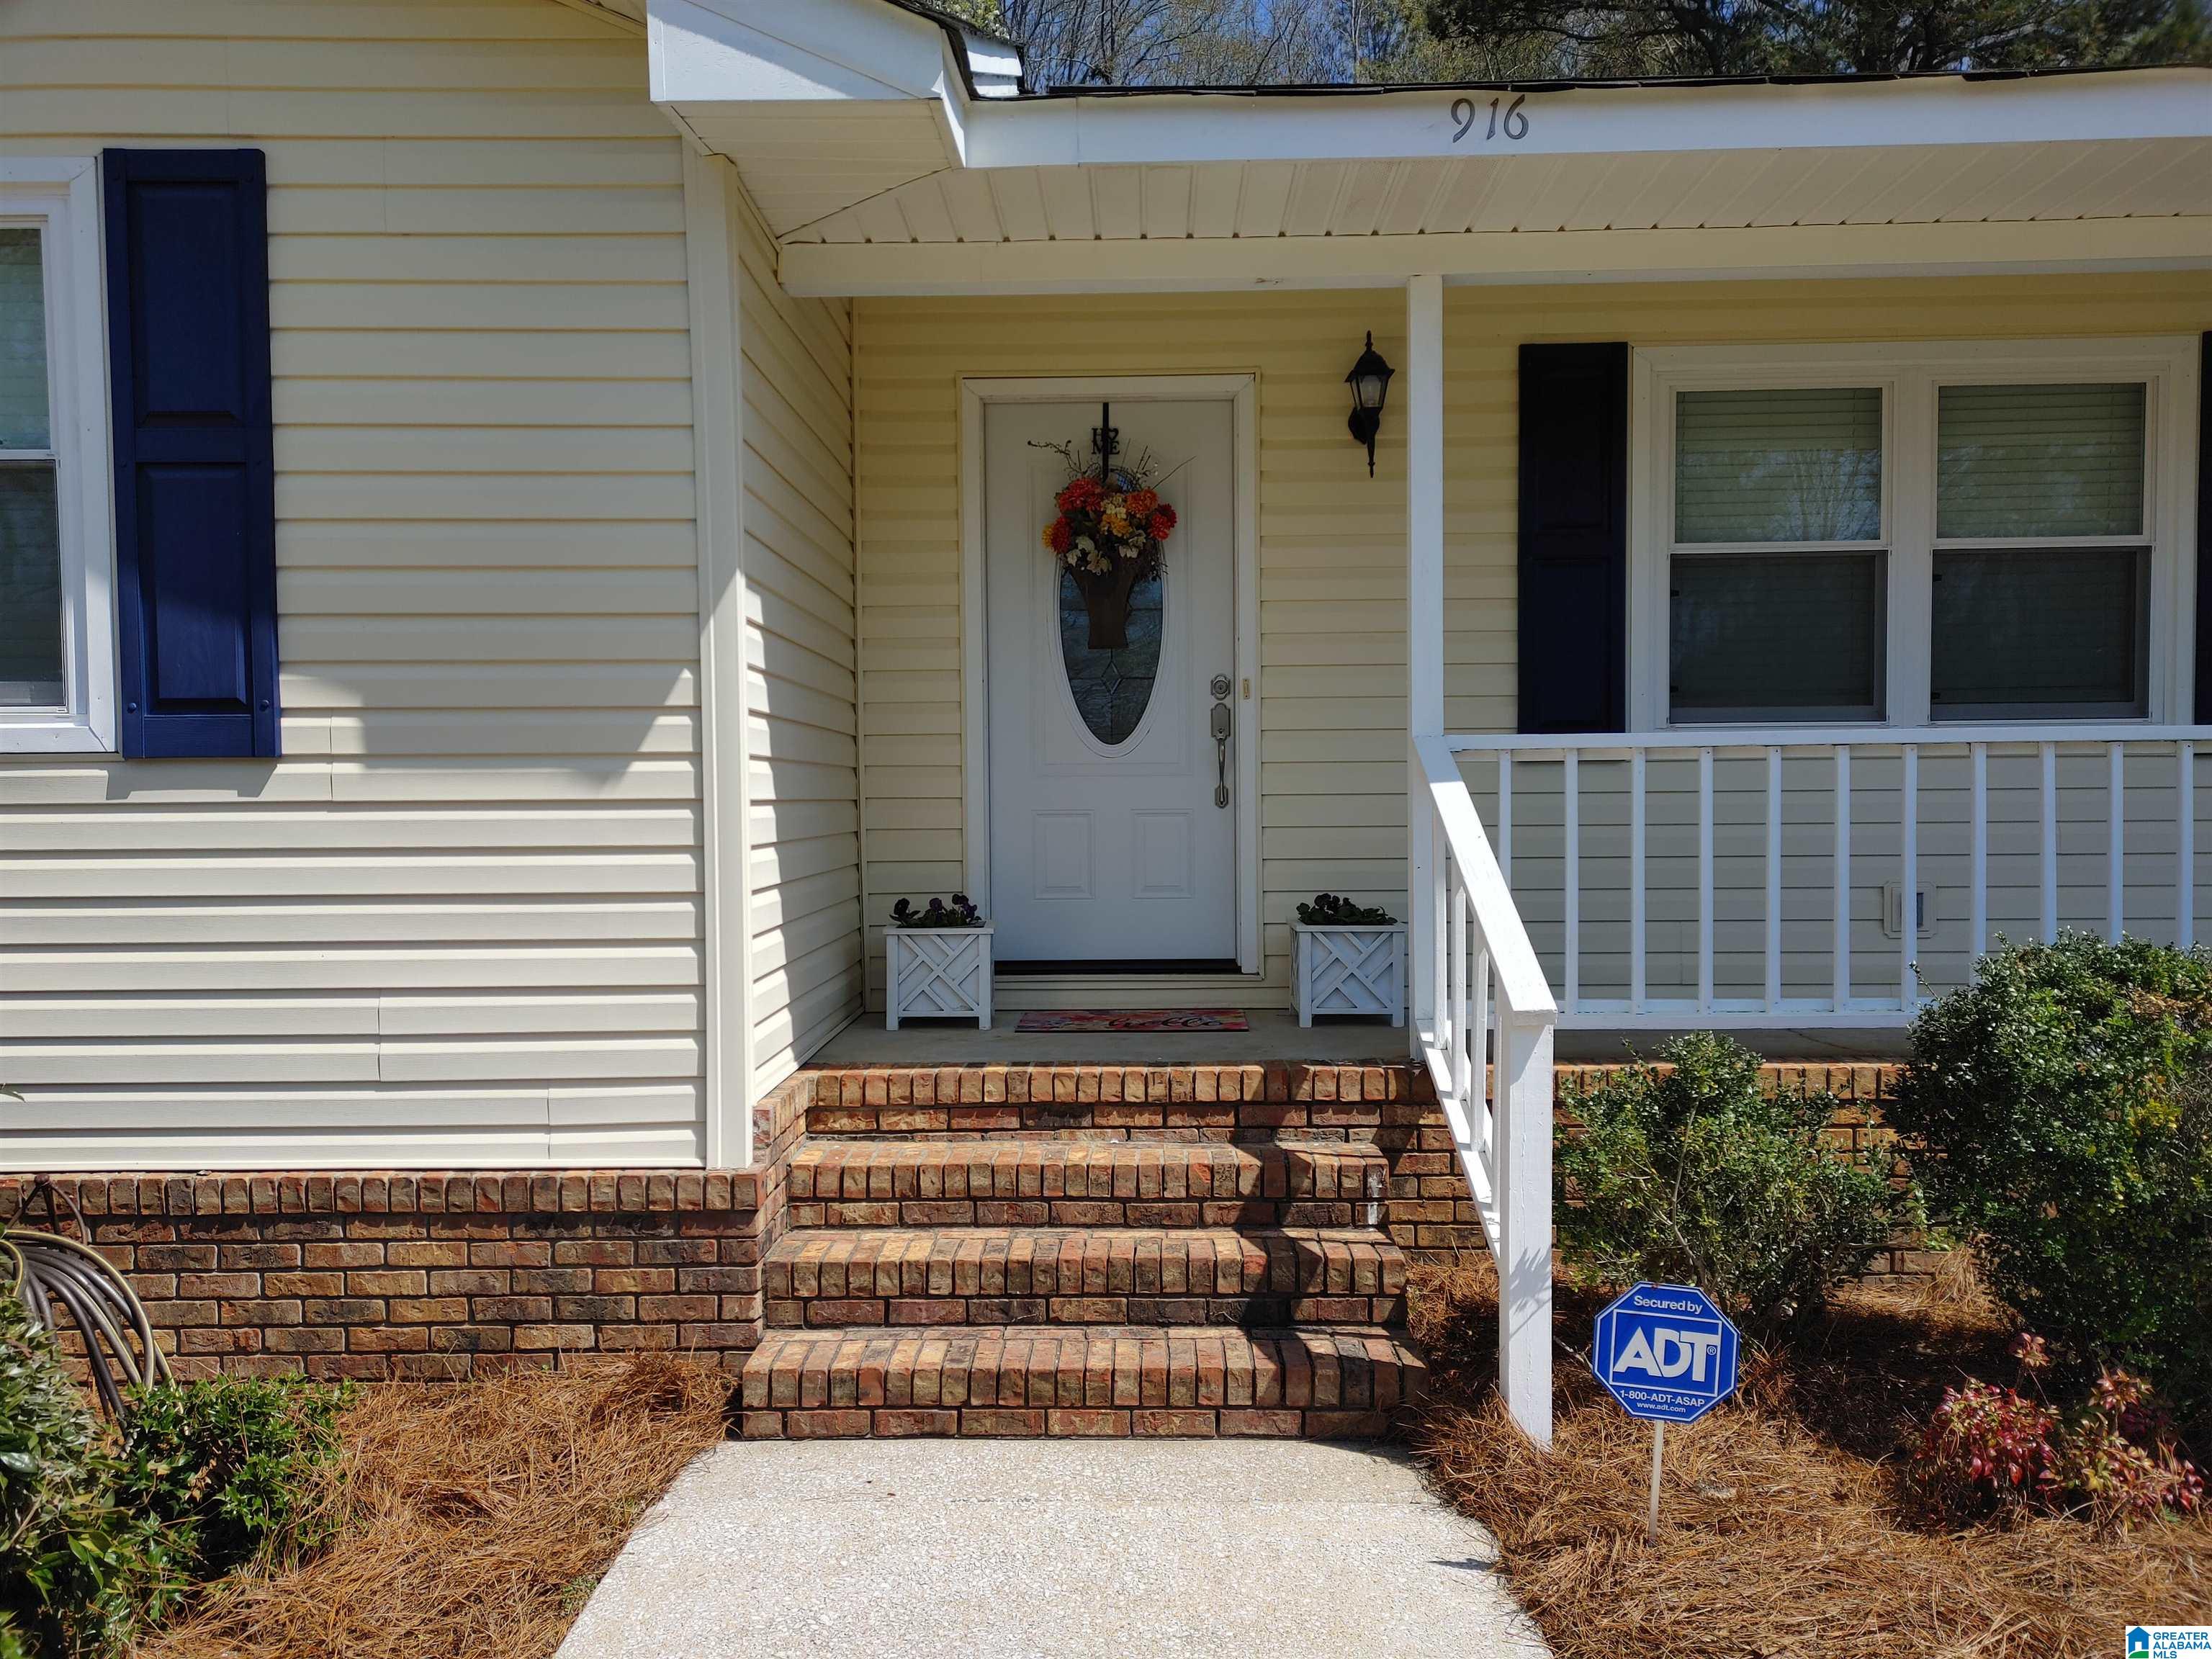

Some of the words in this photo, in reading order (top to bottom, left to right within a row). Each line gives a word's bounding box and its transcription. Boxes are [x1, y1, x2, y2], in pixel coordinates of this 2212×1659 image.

[1451, 94, 1529, 143] 916
[1633, 1295, 1686, 1311] Secured
[1686, 1301, 1703, 1315] by
[1612, 1326, 1720, 1382] ADT
[1619, 1390, 1705, 1407] 1-800-ADT-ASAP
[1636, 1401, 1686, 1413] www.adt.com
